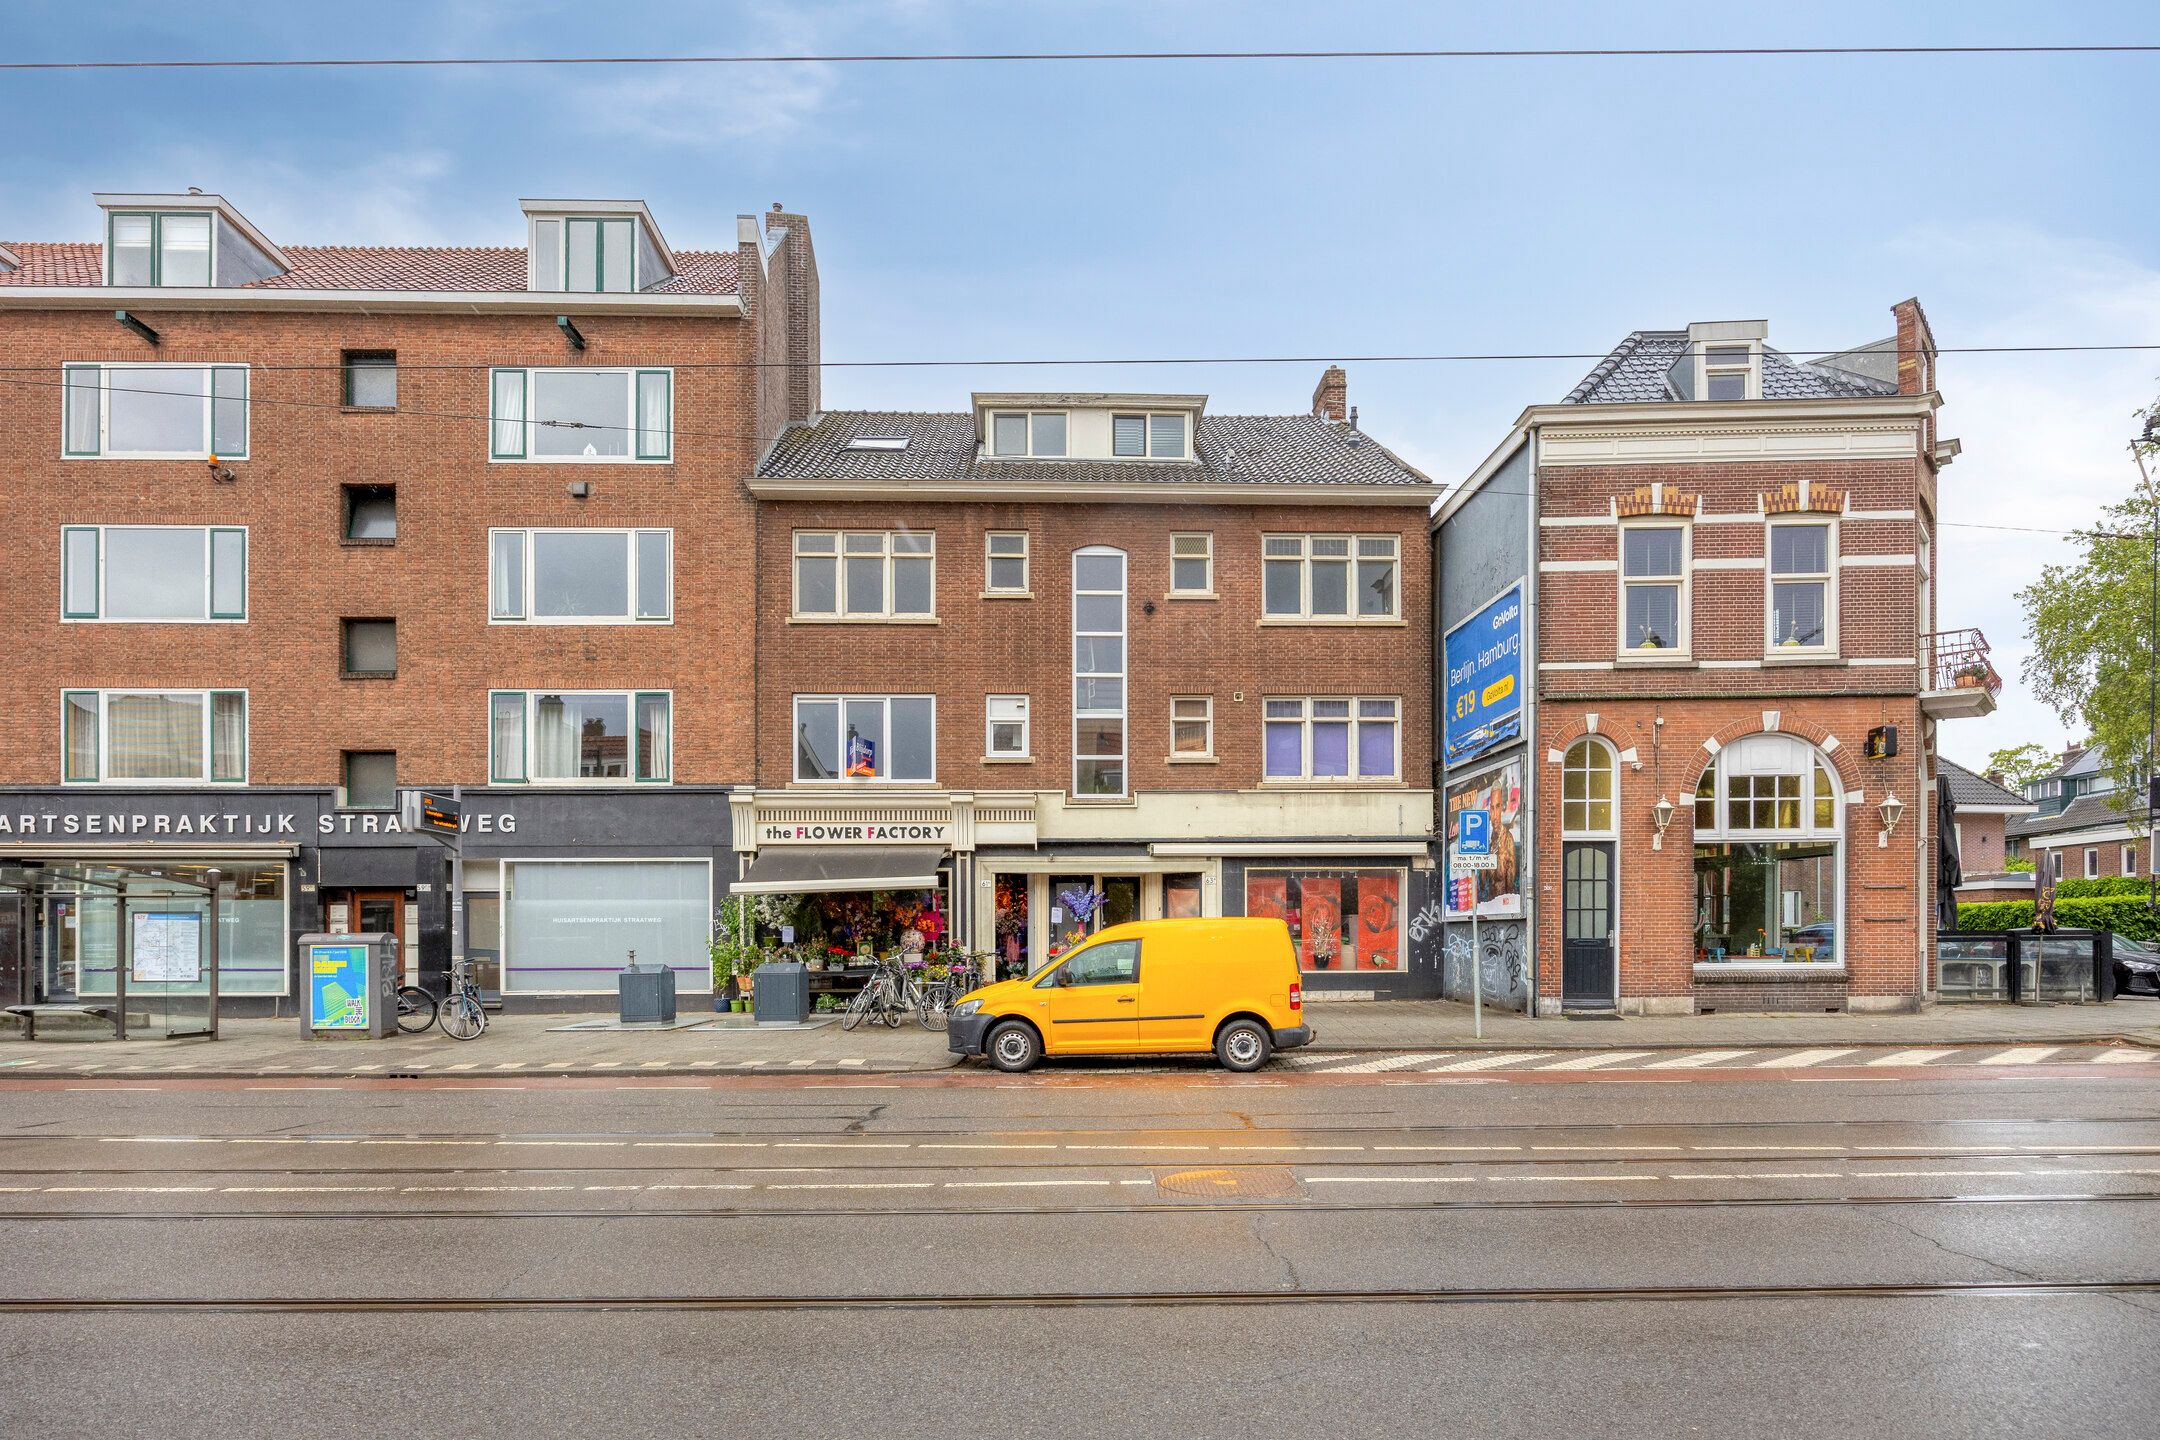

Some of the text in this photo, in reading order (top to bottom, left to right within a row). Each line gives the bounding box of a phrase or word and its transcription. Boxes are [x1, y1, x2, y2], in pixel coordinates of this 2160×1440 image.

[1493, 605, 1518, 630] GoVolta
[1451, 632, 1521, 687] Berlijn. Hamburg.
[1486, 681, 1509, 701] GoVolta.nl
[1456, 690, 1476, 719] €19
[766, 826, 945, 839] the FLOWER FACTORY
[1465, 814, 1482, 836] P
